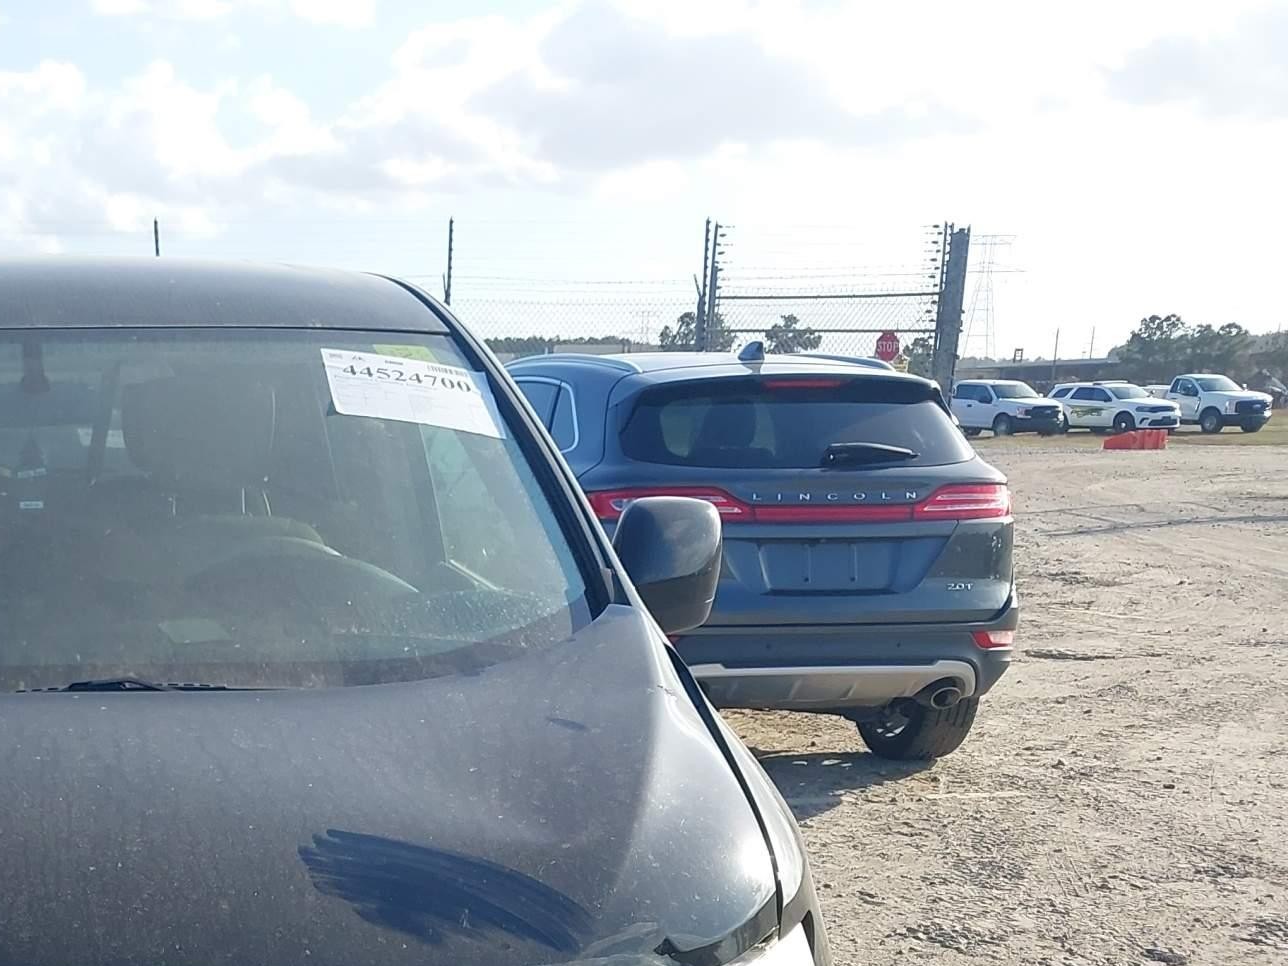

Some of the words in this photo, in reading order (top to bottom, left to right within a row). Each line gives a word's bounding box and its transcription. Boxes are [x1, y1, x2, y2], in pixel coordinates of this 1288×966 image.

[877, 341, 899, 352] STOP
[343, 365, 471, 392] 44524700
[753, 492, 917, 500] LINCOLN
